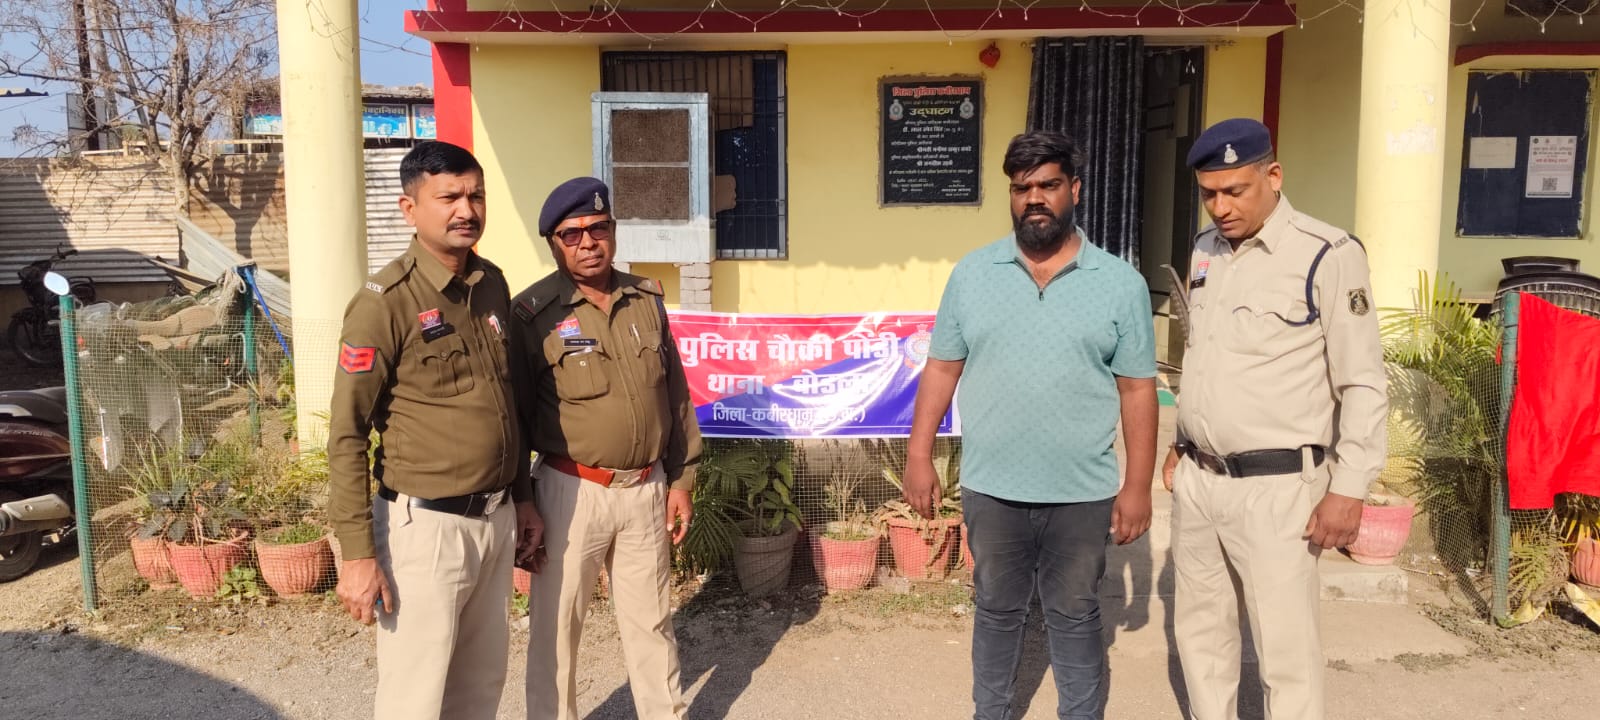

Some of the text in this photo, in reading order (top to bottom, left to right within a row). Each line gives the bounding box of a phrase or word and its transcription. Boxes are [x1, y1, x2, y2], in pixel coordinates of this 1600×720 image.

[914, 86, 936, 98] पुलिस
[679, 331, 901, 366] पुलिस चौकी पोंडी
[707, 373, 766, 395] थाना
